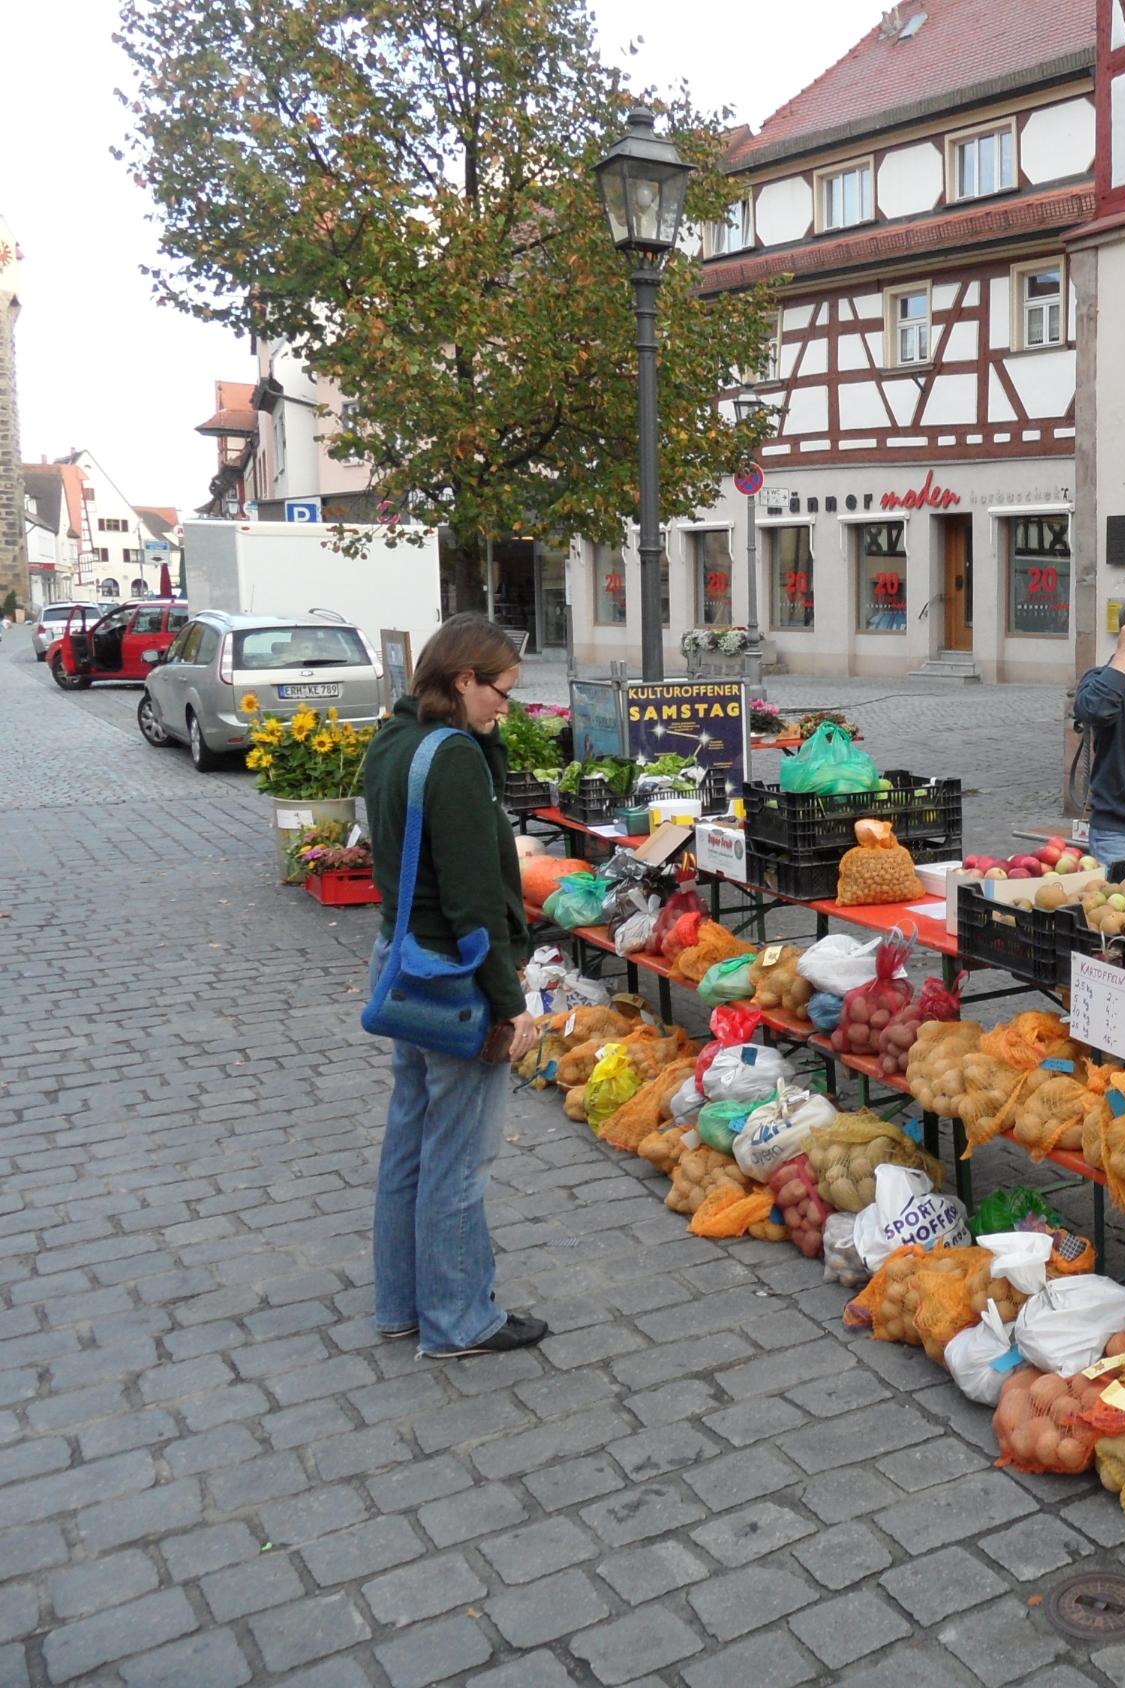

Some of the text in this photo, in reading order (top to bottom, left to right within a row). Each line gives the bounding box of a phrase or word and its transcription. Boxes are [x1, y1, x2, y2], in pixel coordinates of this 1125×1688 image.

[880, 469, 960, 510] moden
[605, 574, 623, 592] 20
[707, 571, 730, 593] 20
[786, 571, 808, 593] 20
[874, 573, 899, 595] 20
[1027, 566, 1057, 593] 20
[628, 685, 740, 699] KULTUROFFENER
[629, 702, 740, 721] SAMSTAG
[884, 1199, 937, 1240] SPORT
